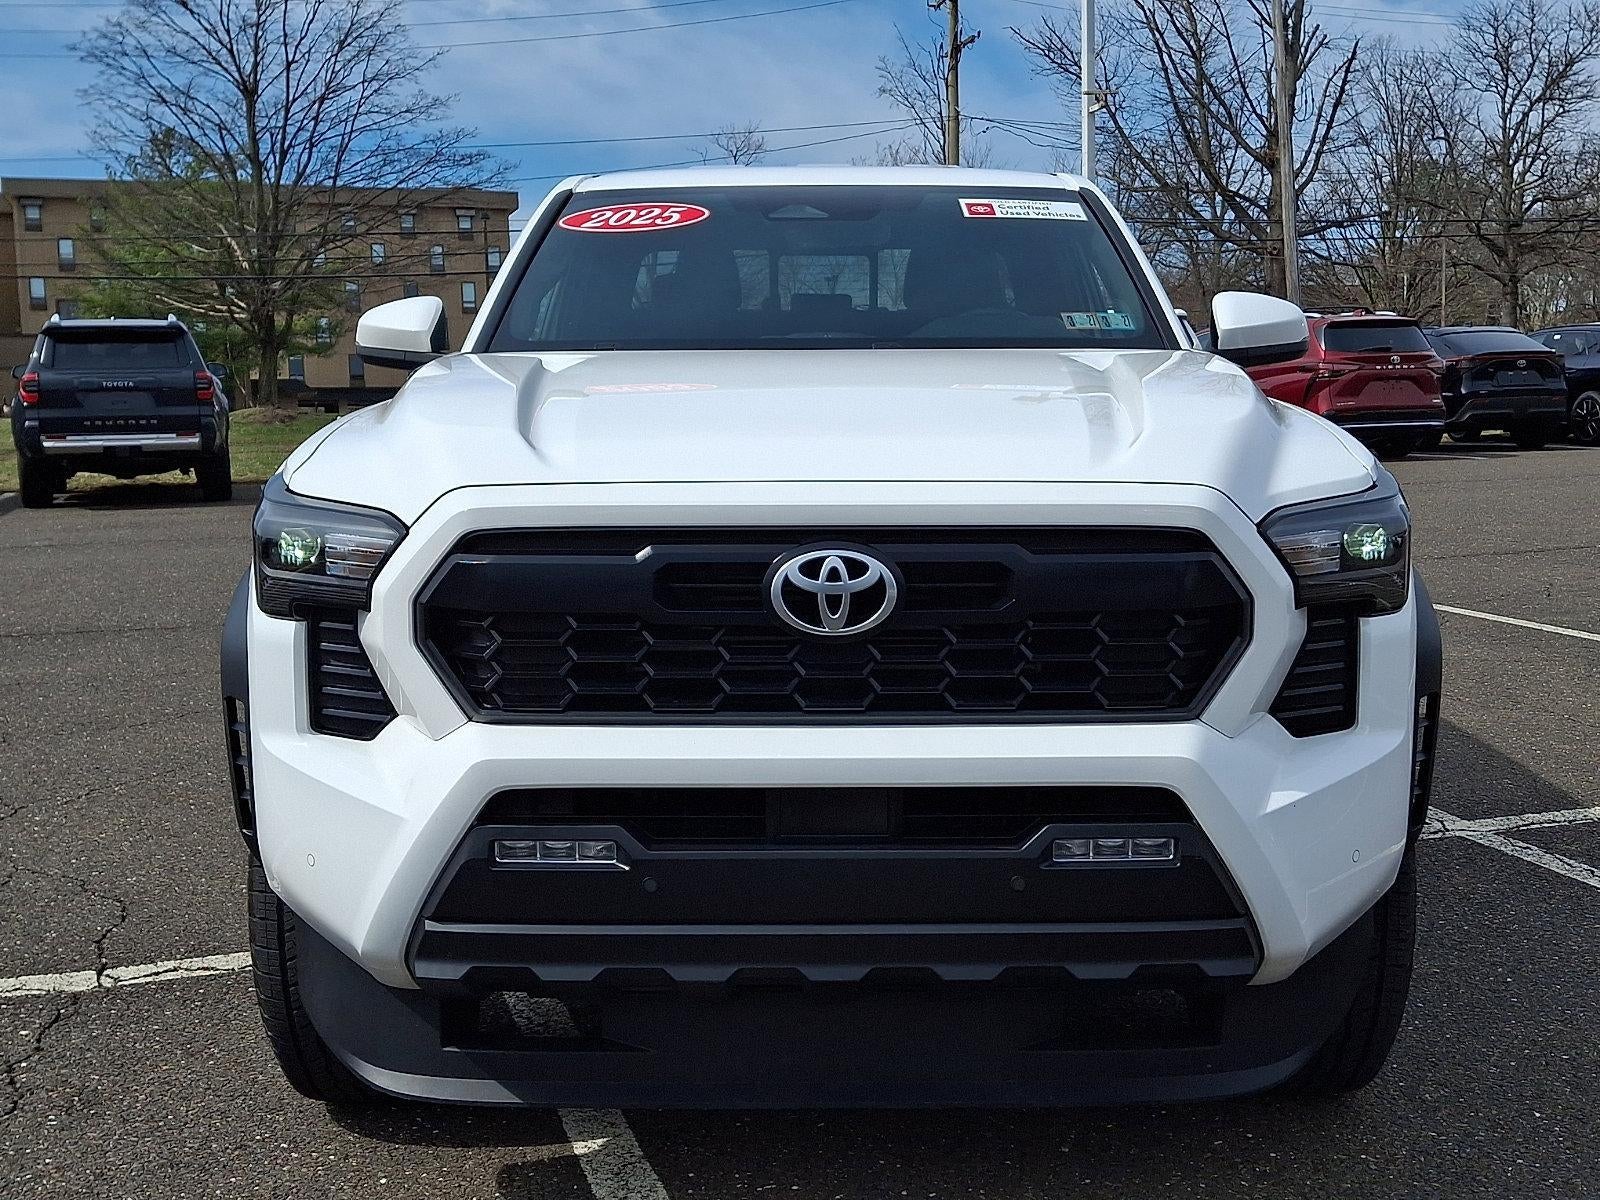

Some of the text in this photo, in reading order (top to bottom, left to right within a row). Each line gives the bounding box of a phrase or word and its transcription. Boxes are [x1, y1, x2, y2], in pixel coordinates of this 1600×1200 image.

[997, 203, 1051, 212] Certified
[580, 207, 688, 228] 2025
[1033, 211, 1083, 219] Vehicles
[1067, 315, 1076, 327] 3
[1102, 315, 1111, 327] 3
